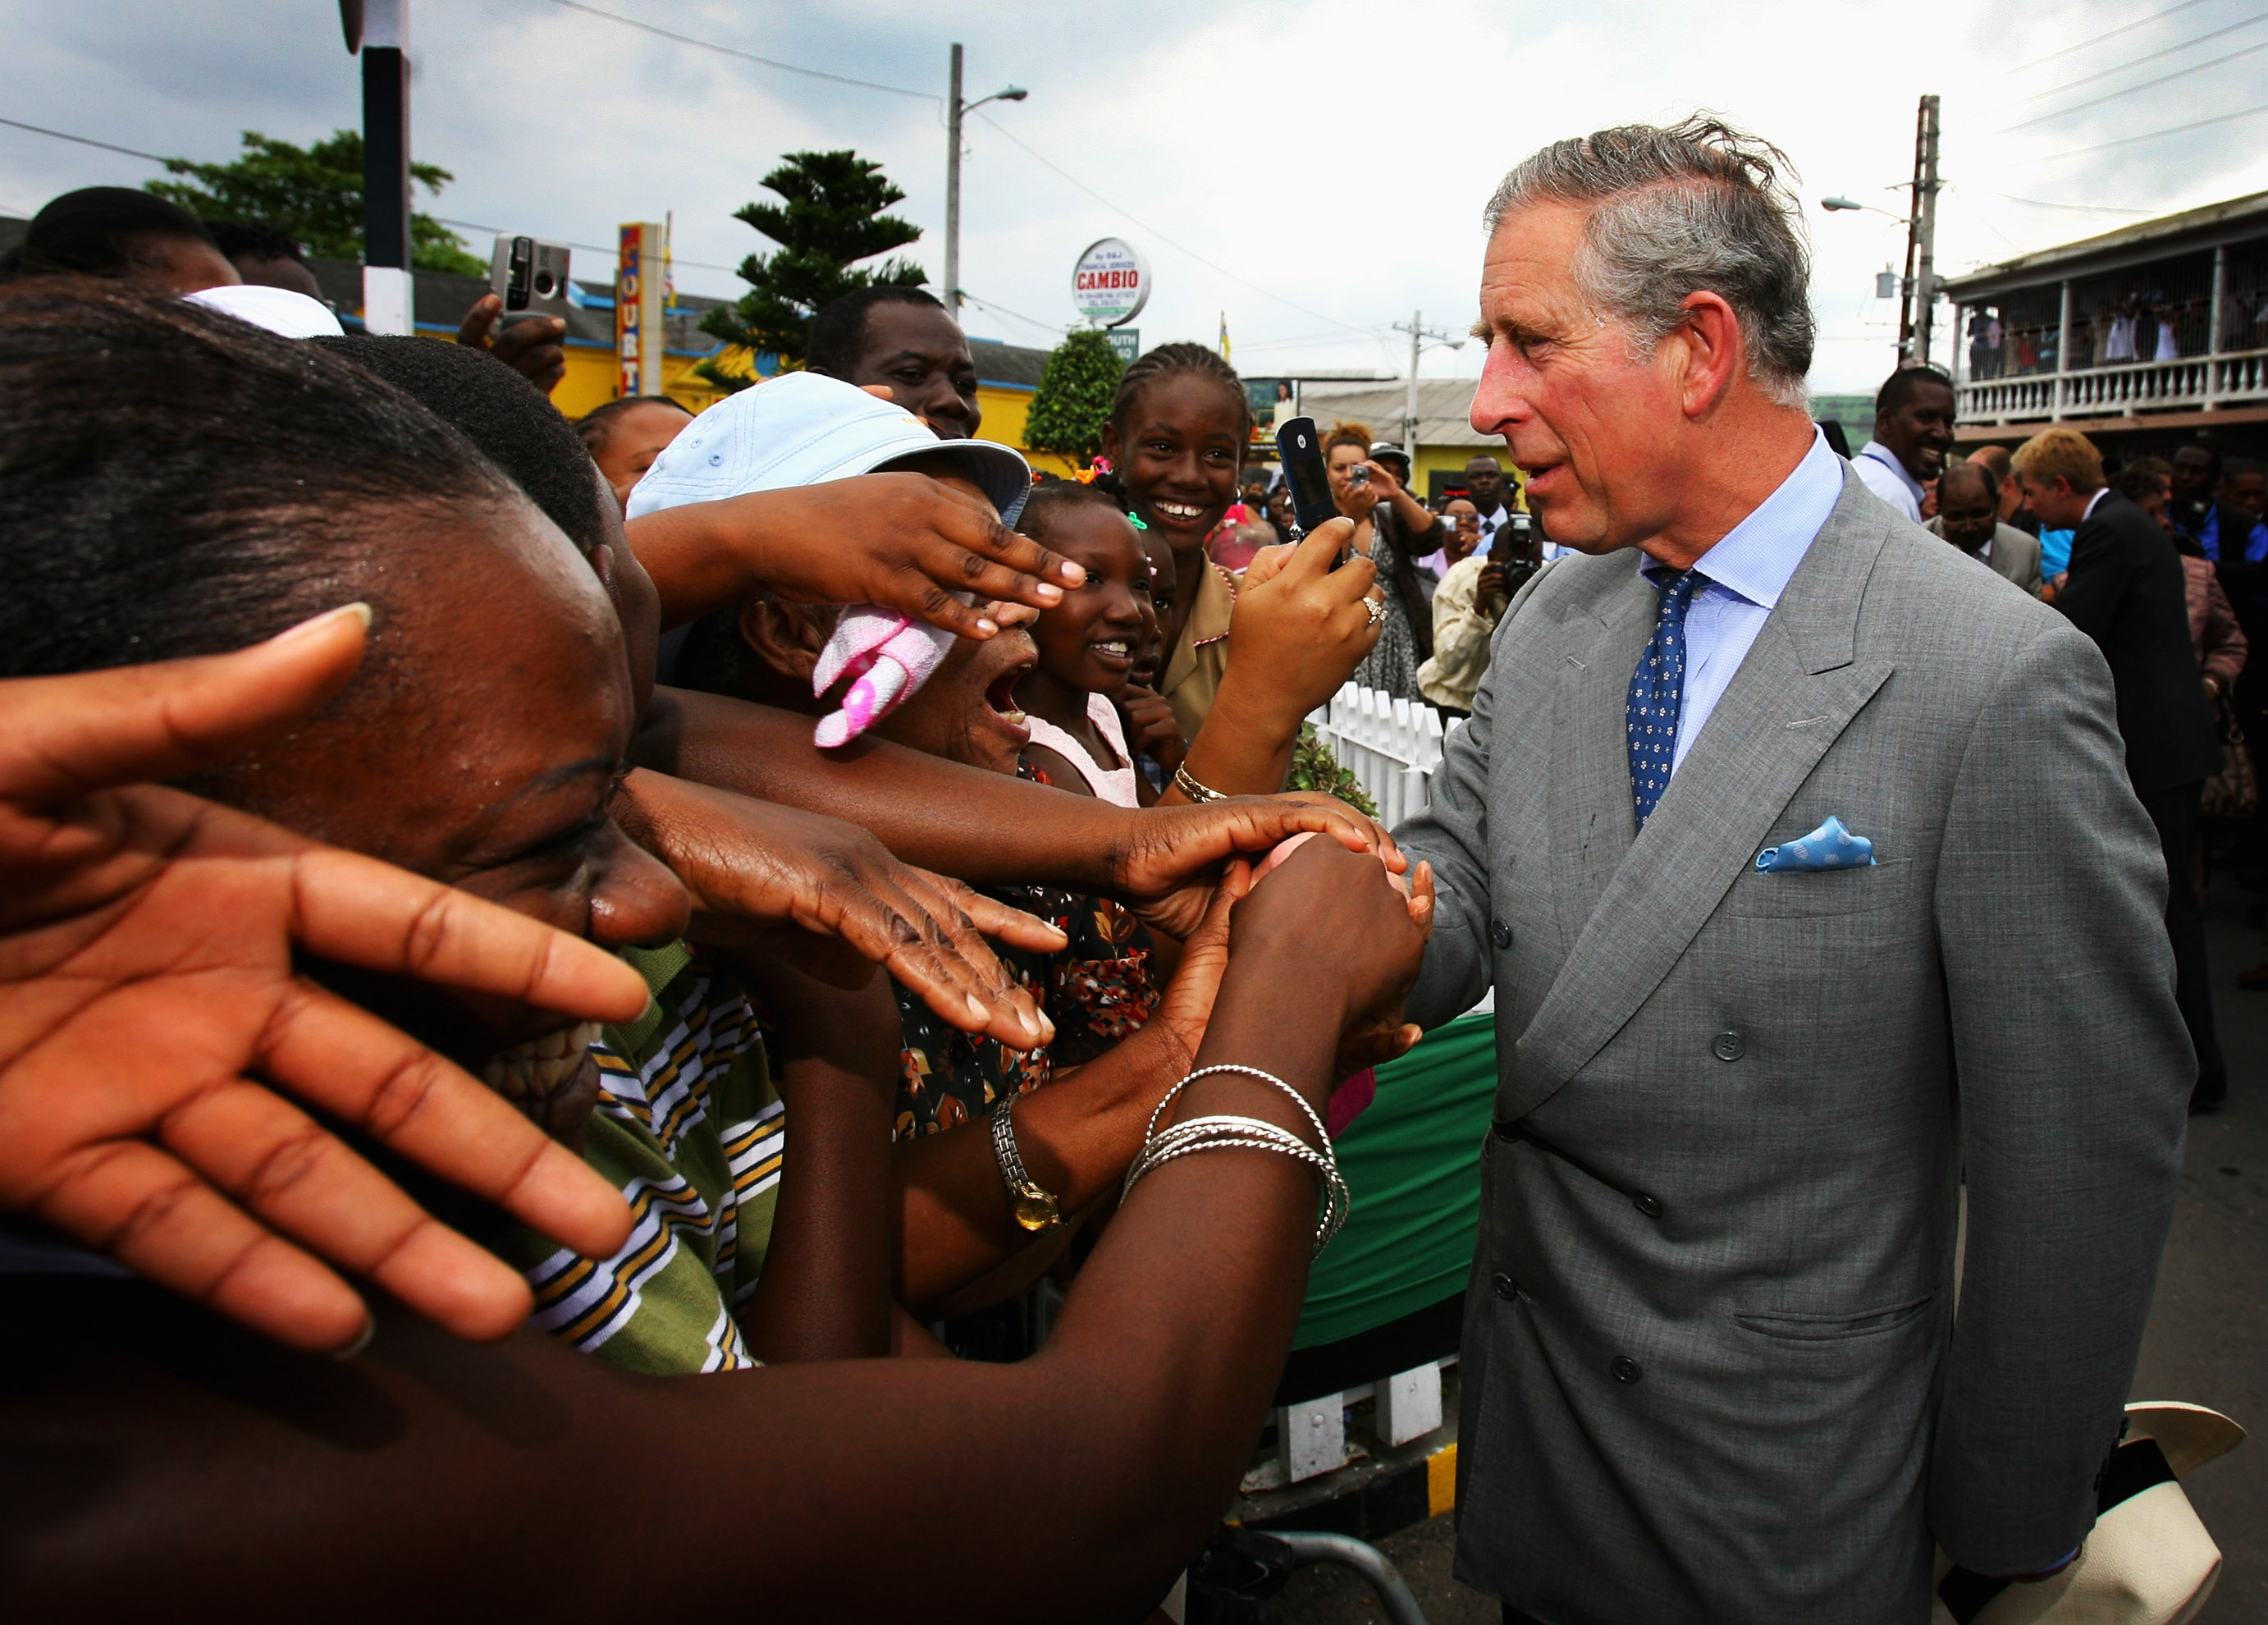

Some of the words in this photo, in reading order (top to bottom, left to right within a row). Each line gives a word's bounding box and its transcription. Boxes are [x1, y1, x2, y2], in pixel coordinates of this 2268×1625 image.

[1077, 271, 1138, 290] CAMBIO
[621, 243, 638, 396] COURT
[1106, 335, 1136, 346] OUTH
